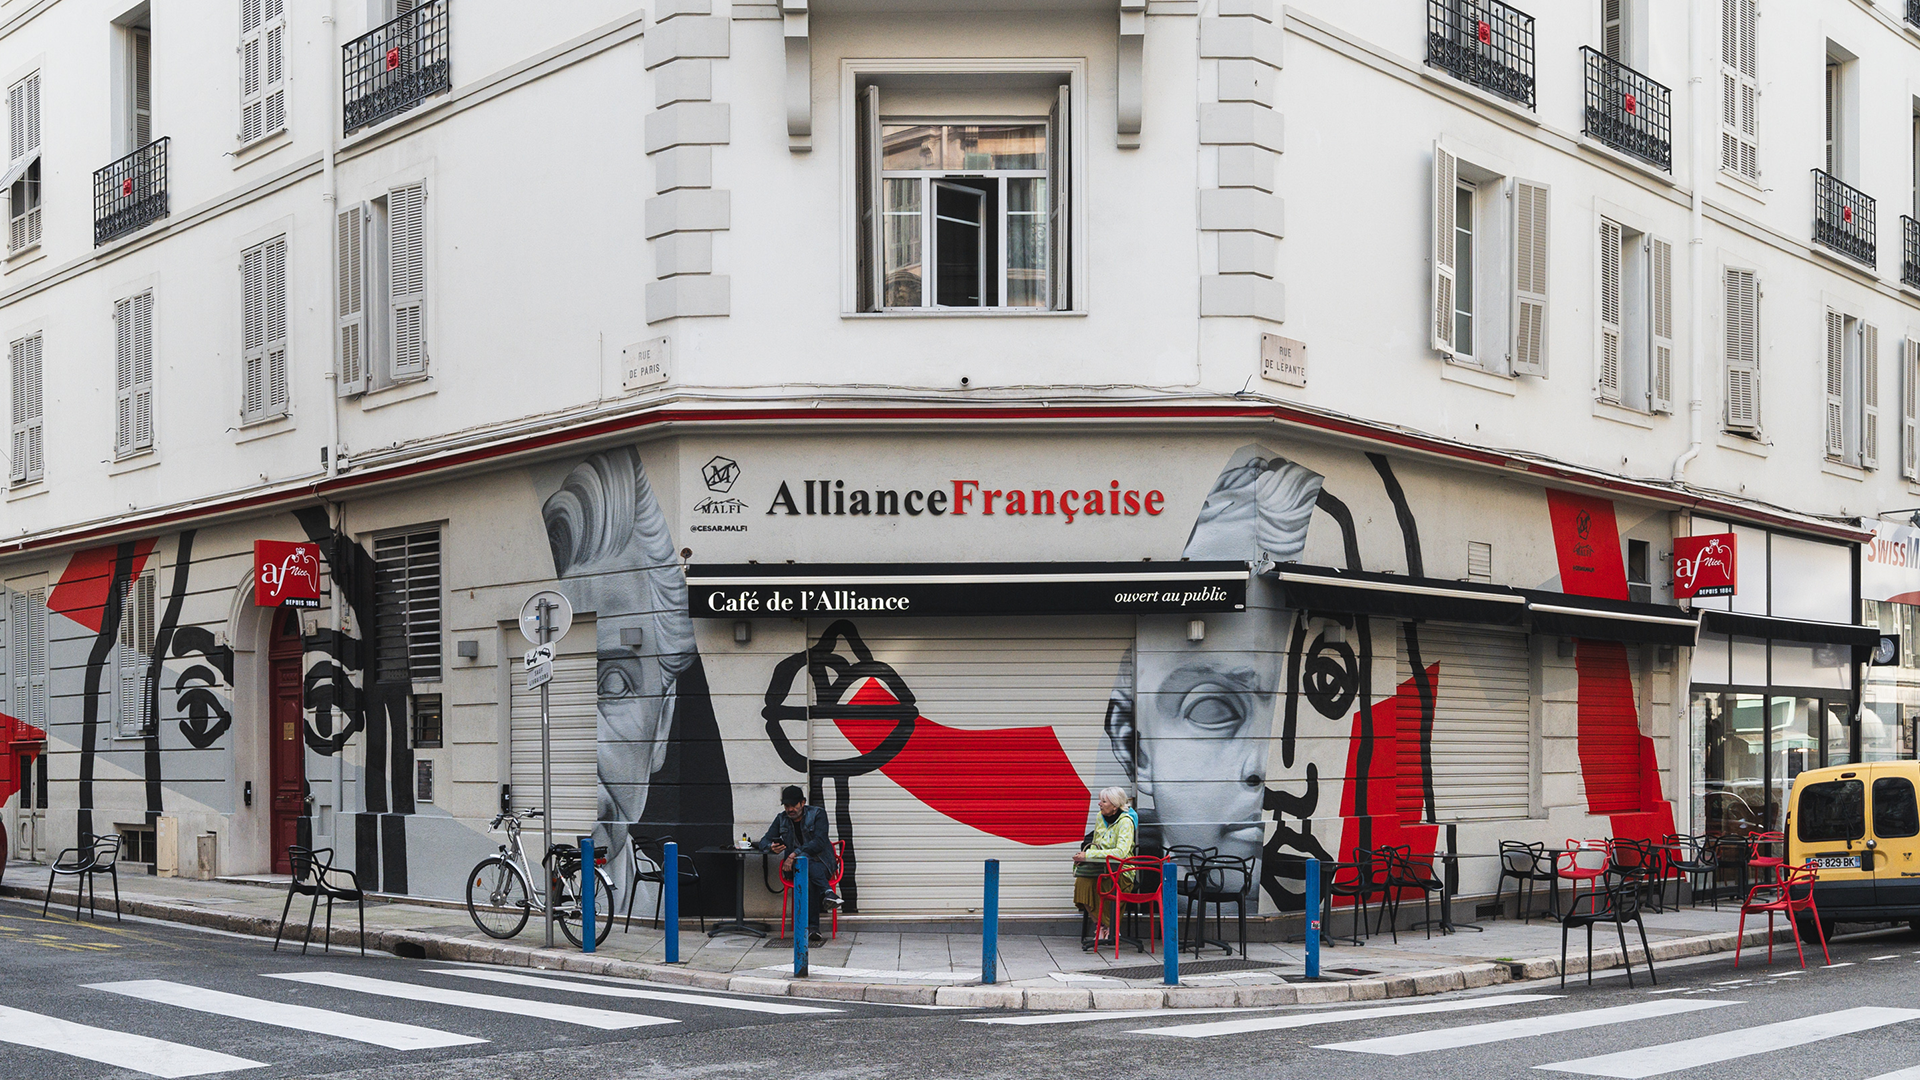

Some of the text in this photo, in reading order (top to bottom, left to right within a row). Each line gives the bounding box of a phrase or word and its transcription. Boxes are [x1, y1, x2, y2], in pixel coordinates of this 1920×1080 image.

[638, 350, 650, 360] RUE
[1279, 346, 1292, 357] RUE
[1265, 359, 1273, 369] DE
[629, 363, 660, 379] DE PARIS
[701, 505, 741, 514] MALFI
[690, 525, 748, 533] @CESAR.MALFI
[1676, 546, 1710, 589] af
[1704, 557, 1721, 567] Nice
[261, 554, 296, 597] af
[290, 565, 307, 577] Nice
[708, 590, 910, 611] Café de l’Alliance
[1114, 586, 1227, 606] ouvert au public
